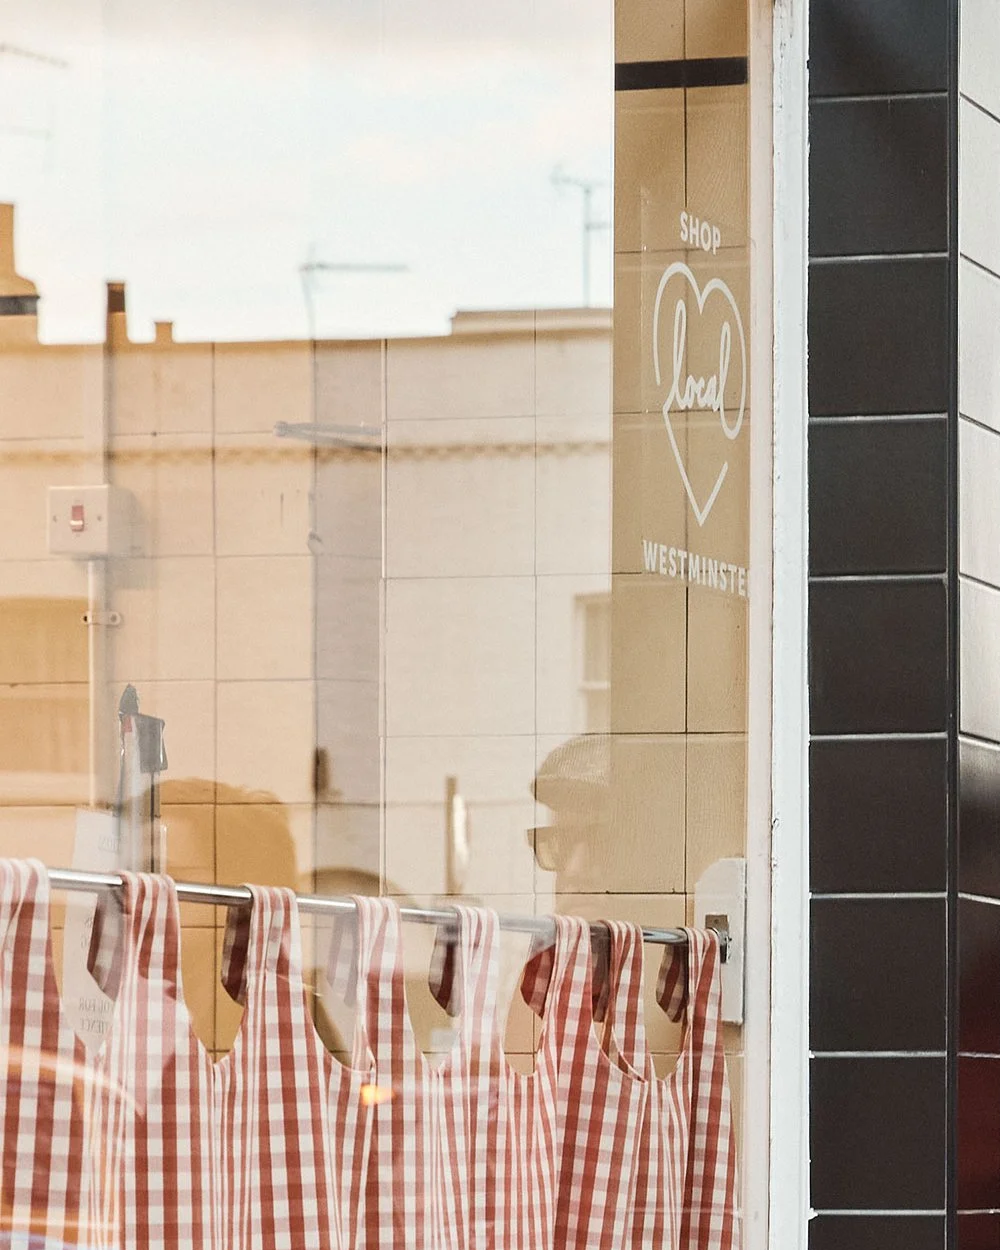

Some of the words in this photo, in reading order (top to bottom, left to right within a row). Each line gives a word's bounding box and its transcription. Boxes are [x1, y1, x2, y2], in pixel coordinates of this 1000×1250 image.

[679, 211, 721, 255] SHOP
[673, 299, 731, 413] local
[642, 540, 749, 598] WESTMINSTE
